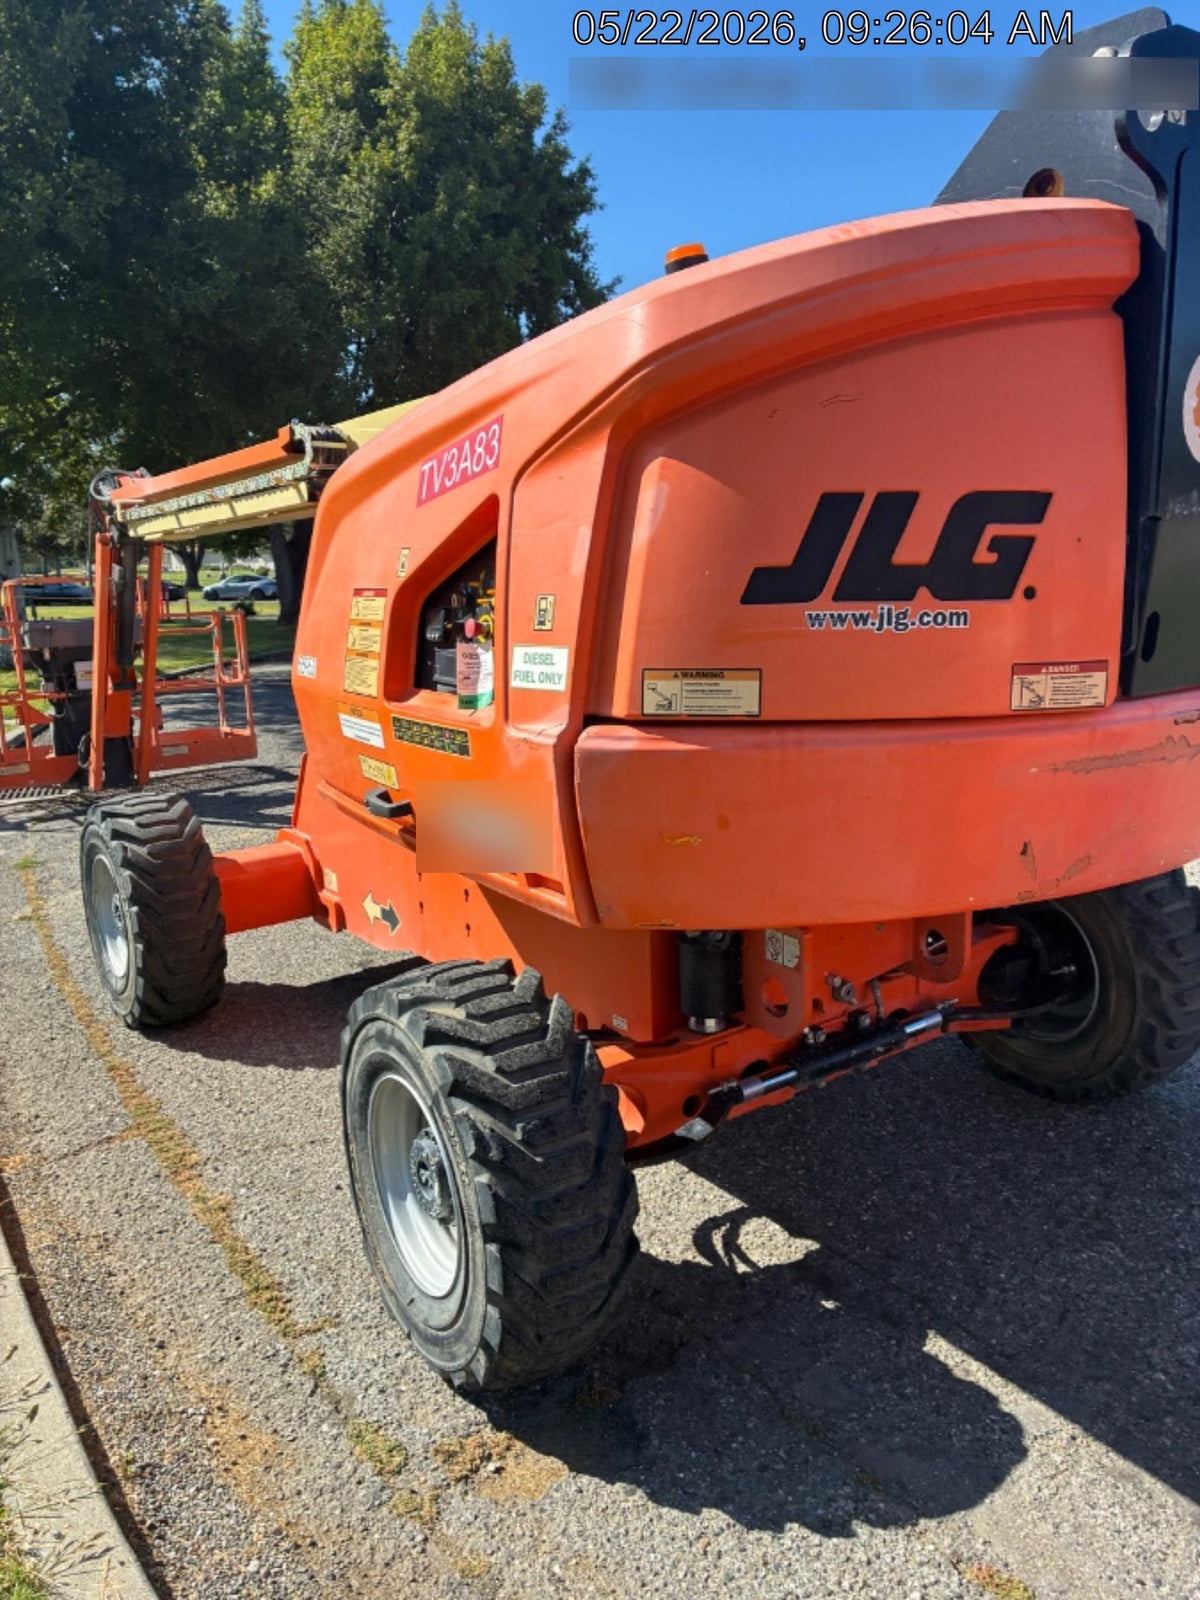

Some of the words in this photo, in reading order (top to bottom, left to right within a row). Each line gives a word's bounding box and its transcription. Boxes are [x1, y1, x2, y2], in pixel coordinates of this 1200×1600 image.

[421, 423, 499, 500] TV3A83
[806, 606, 969, 632] www.jlg.com
[523, 652, 555, 666] DIESEL
[514, 670, 536, 684] FUEL
[538, 671, 563, 685] ONLY
[681, 671, 725, 679] WARNING
